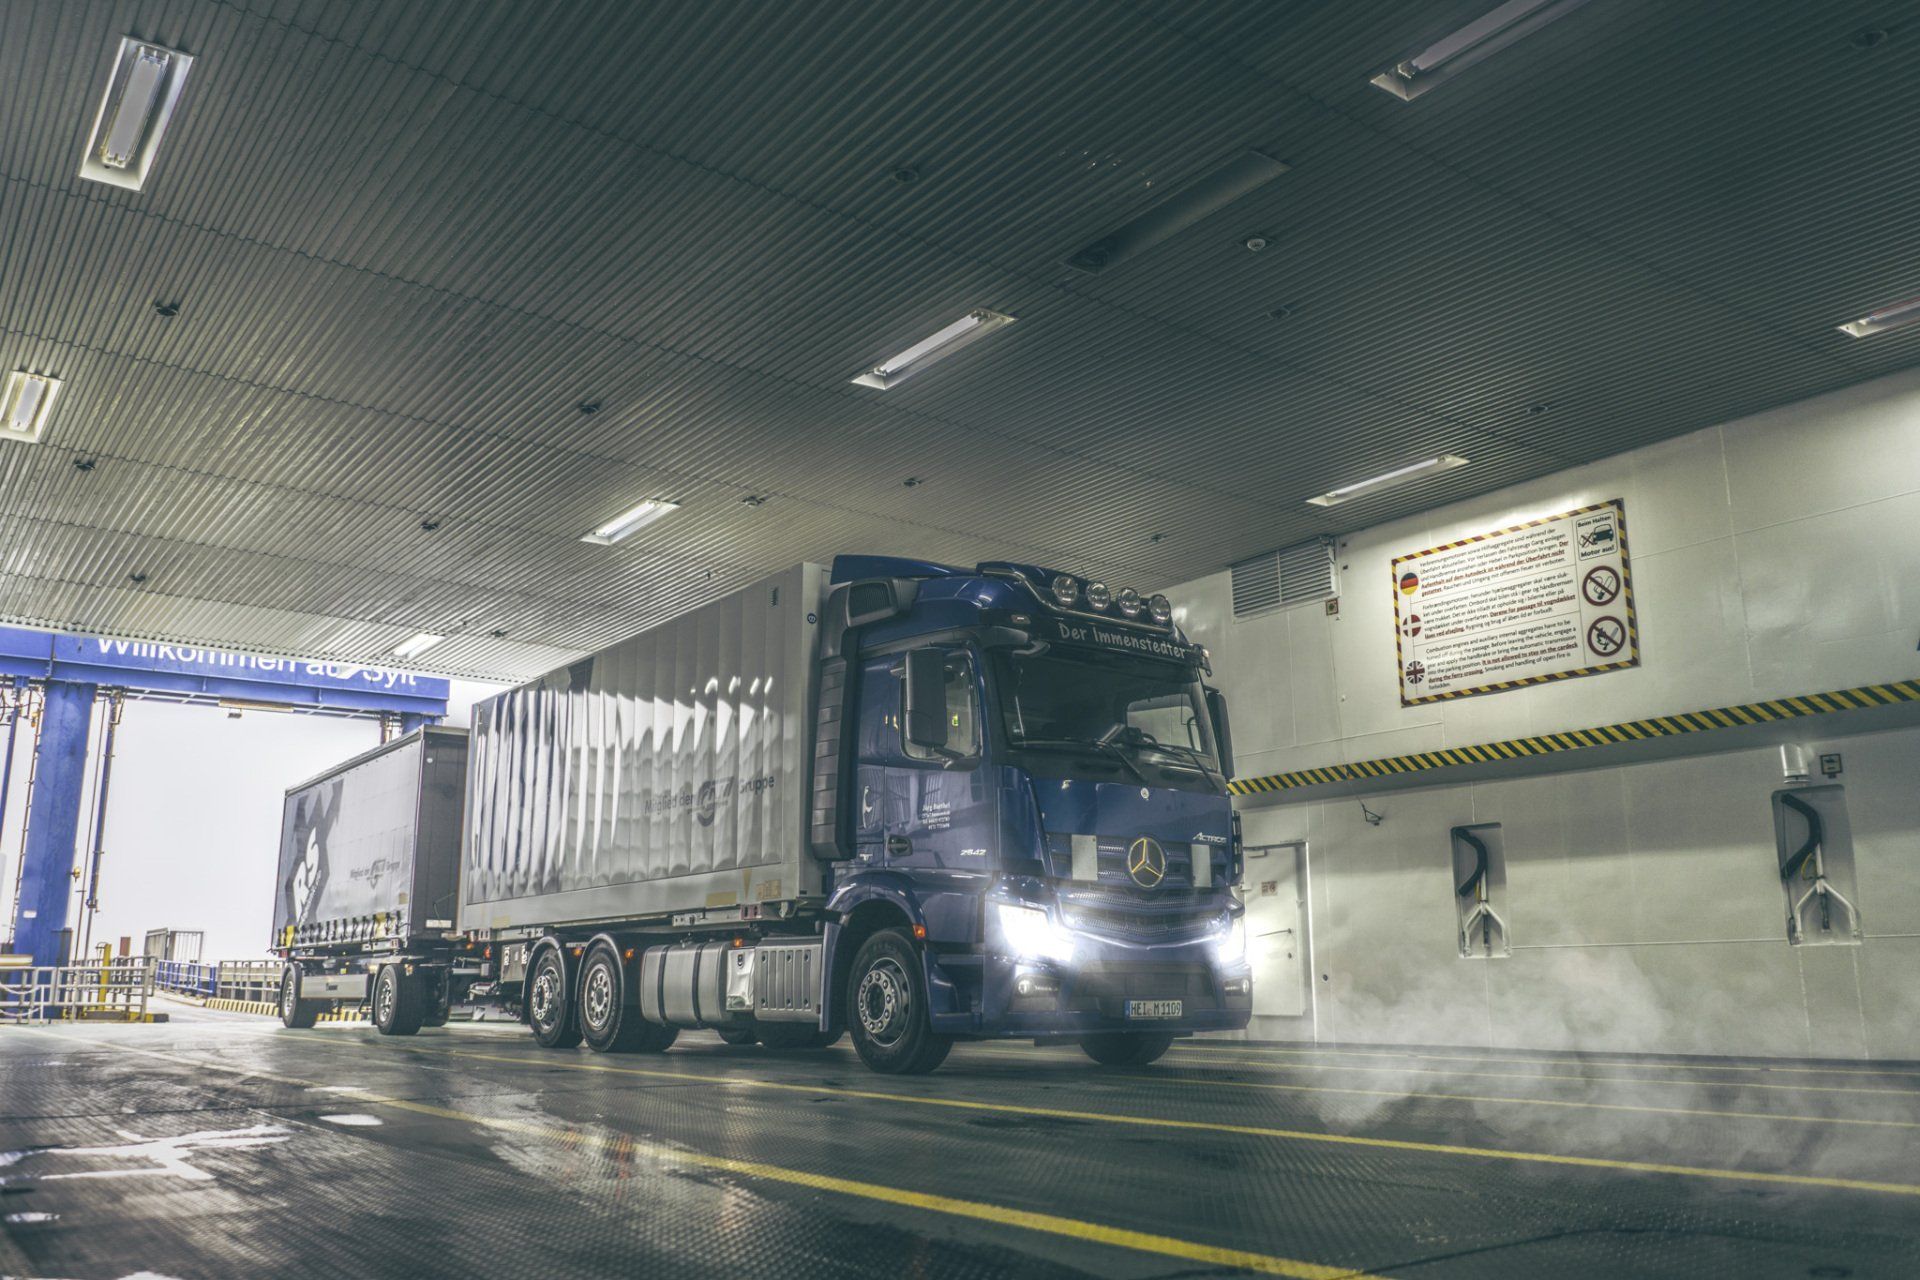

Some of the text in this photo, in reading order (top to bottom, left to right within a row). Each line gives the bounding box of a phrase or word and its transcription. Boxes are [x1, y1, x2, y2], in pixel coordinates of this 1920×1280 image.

[1526, 552, 1550, 562] Überfahrt
[1581, 548, 1600, 558] Motor
[1058, 622, 1186, 658] Der Immenstedter
[1445, 665, 1461, 673] parking
[1501, 653, 1520, 661] allowed
[1557, 642, 1578, 650] cardeck
[680, 792, 692, 807] der
[1130, 1002, 1146, 1016] HEI
